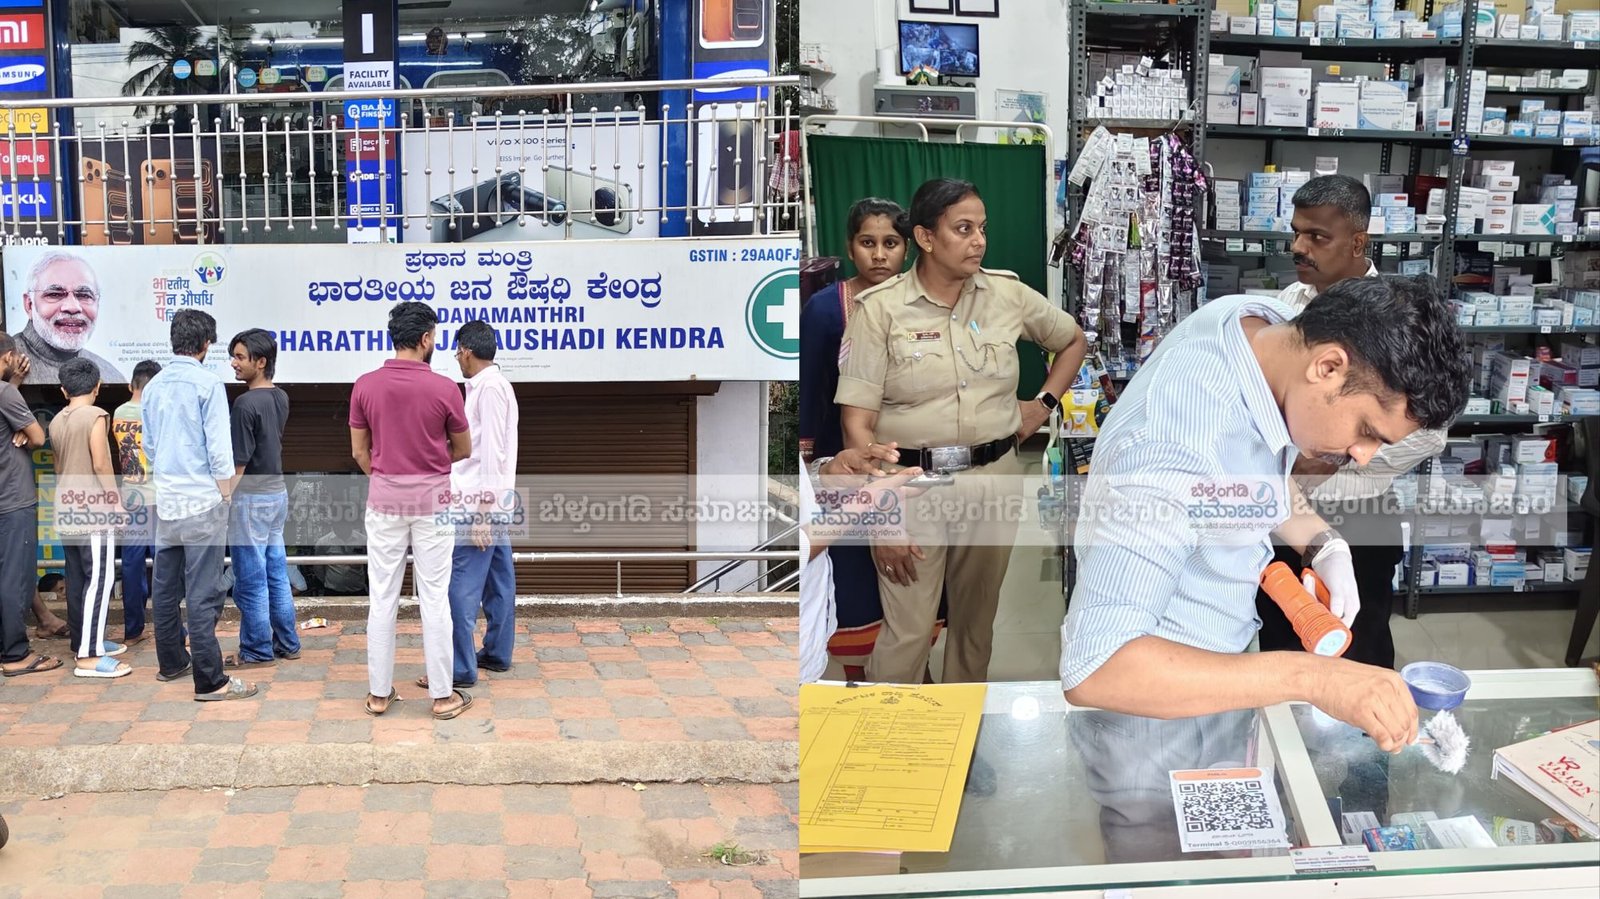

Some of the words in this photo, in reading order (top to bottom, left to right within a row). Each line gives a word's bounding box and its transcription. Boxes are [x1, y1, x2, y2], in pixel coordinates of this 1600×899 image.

[349, 70, 389, 79] FACILITY
[347, 80, 391, 88] AVAILABLE
[2, 193, 47, 205] OKIA
[405, 249, 466, 273] ಪ್ರಧಾನ
[477, 248, 533, 273] ಮಂತ್ರಿ
[689, 249, 728, 262] GSTIN
[741, 248, 799, 262] 29AAQFJ
[153, 276, 190, 291] भारतीय
[308, 274, 436, 306] ಭಾರತೀಯ
[450, 274, 492, 301] ಜನ
[507, 271, 572, 305] ಔಷಧಿ
[587, 271, 662, 309] ಕೇಂದ್ರ
[153, 291, 178, 306] जन
[180, 289, 214, 306] औषधि
[437, 306, 585, 325] DANAMANTHRI
[436, 327, 605, 352] JAAUSHADI
[616, 327, 725, 350] KENDRA
